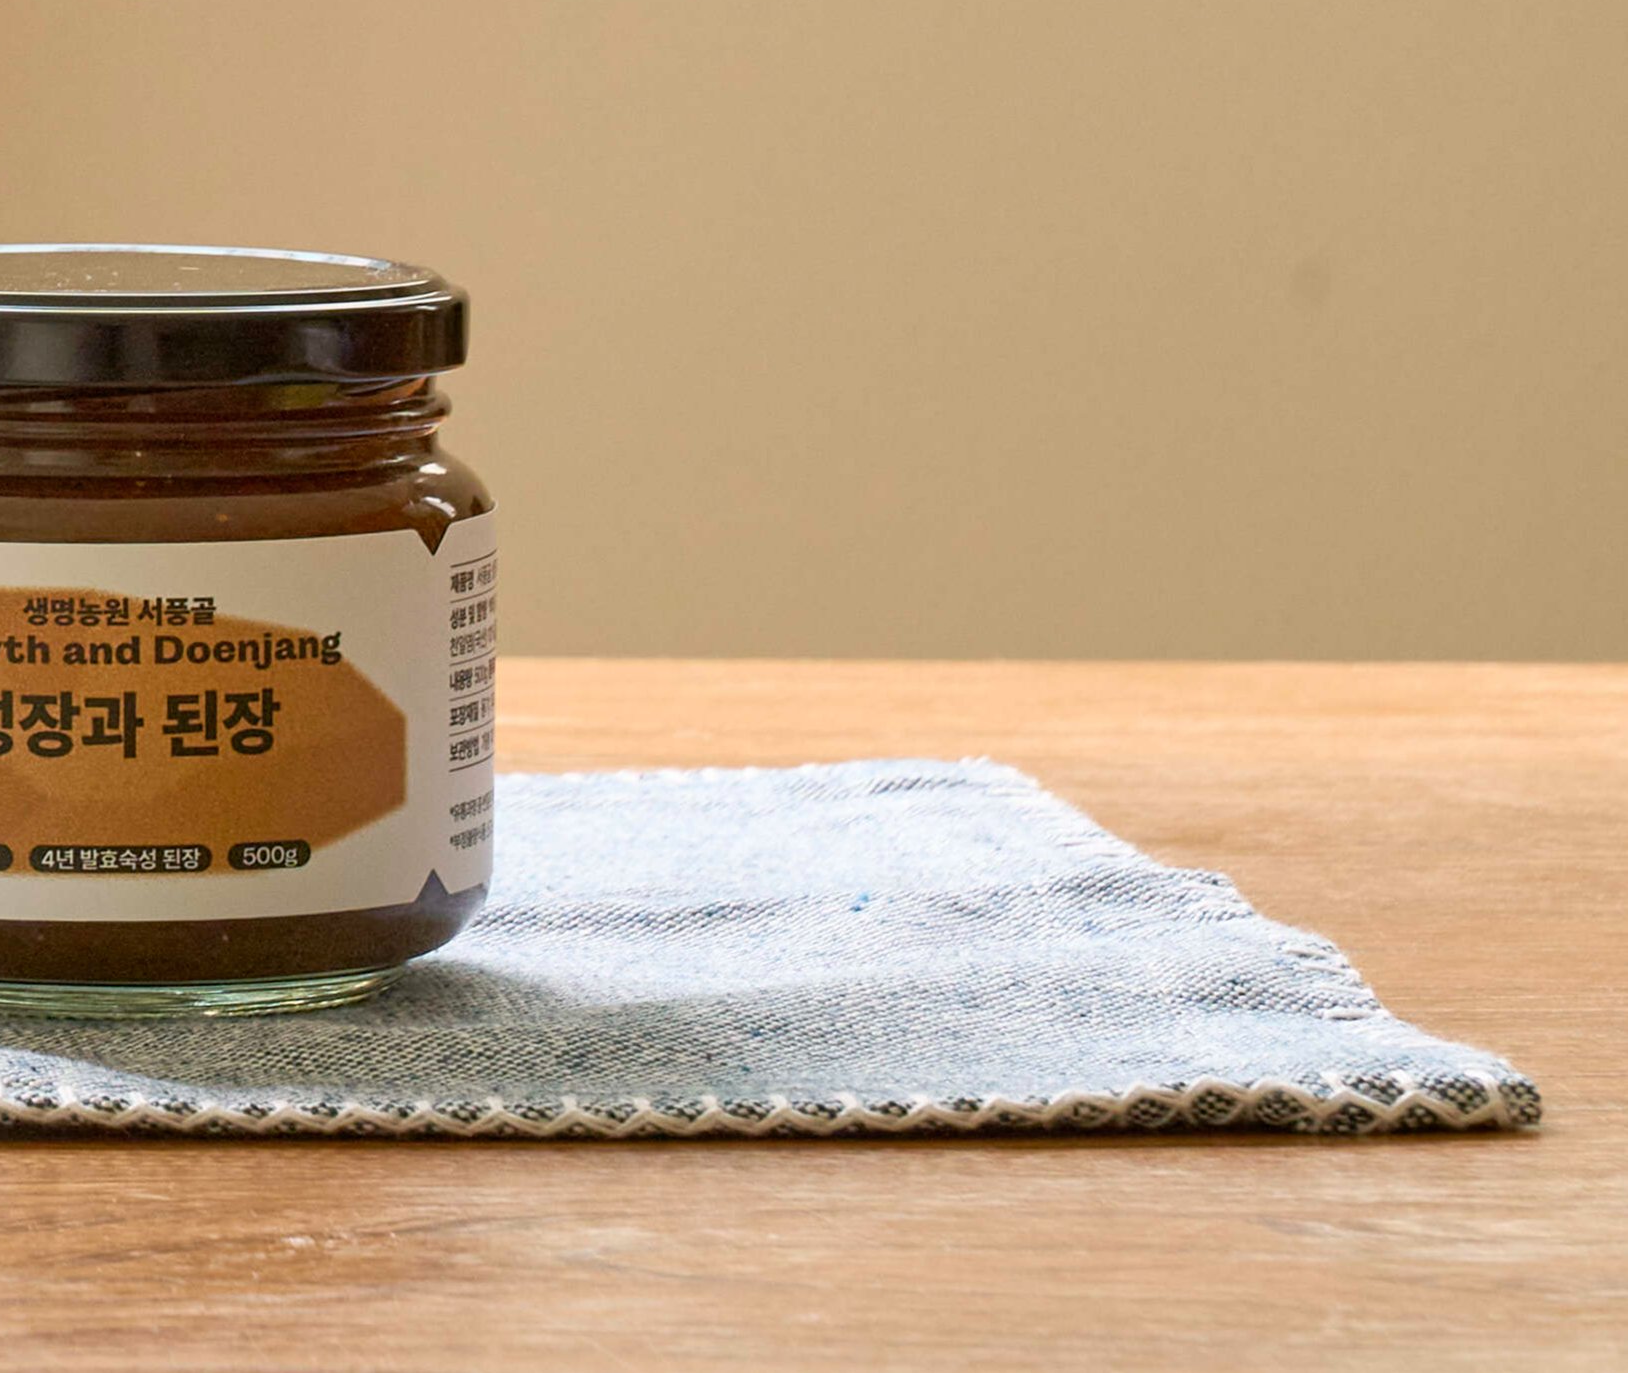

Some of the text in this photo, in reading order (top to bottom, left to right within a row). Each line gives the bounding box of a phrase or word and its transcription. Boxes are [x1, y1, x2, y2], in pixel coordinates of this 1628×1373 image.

[22, 596, 217, 628] 생명농원 서풍골
[62, 635, 141, 666] and
[154, 631, 342, 671] Doenjang
[162, 687, 281, 757] 된장
[41, 848, 201, 871] 4년 발효숙성 된장
[241, 844, 300, 869] 500g
